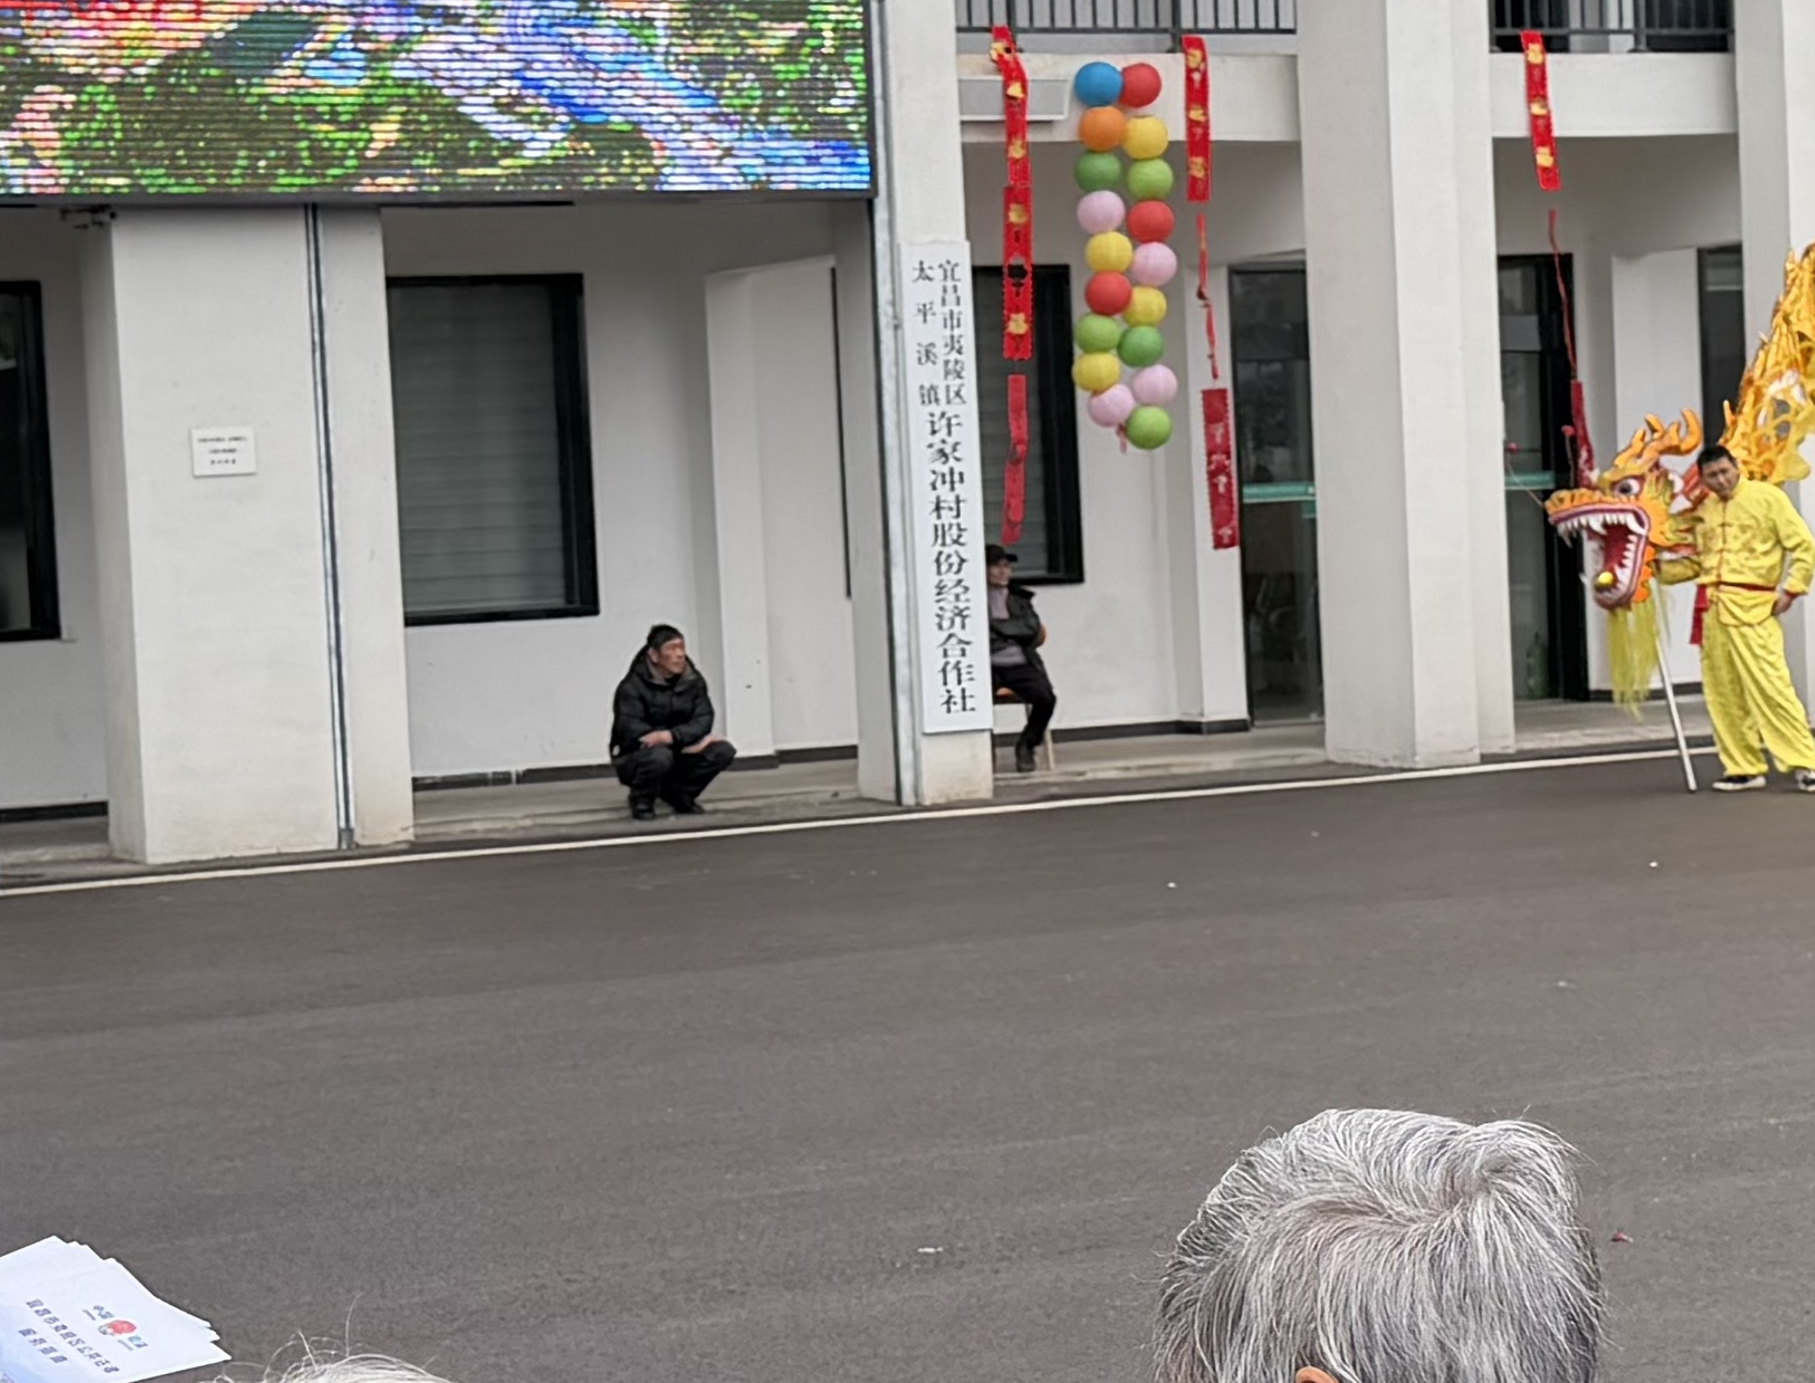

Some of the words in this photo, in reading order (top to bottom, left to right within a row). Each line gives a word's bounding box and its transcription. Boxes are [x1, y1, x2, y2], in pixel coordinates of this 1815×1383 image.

[911, 259, 941, 406] 太平溪镇
[937, 258, 967, 406] 宜昌市夷陵区
[926, 411, 976, 715] 许家冲村股份经济合作社
